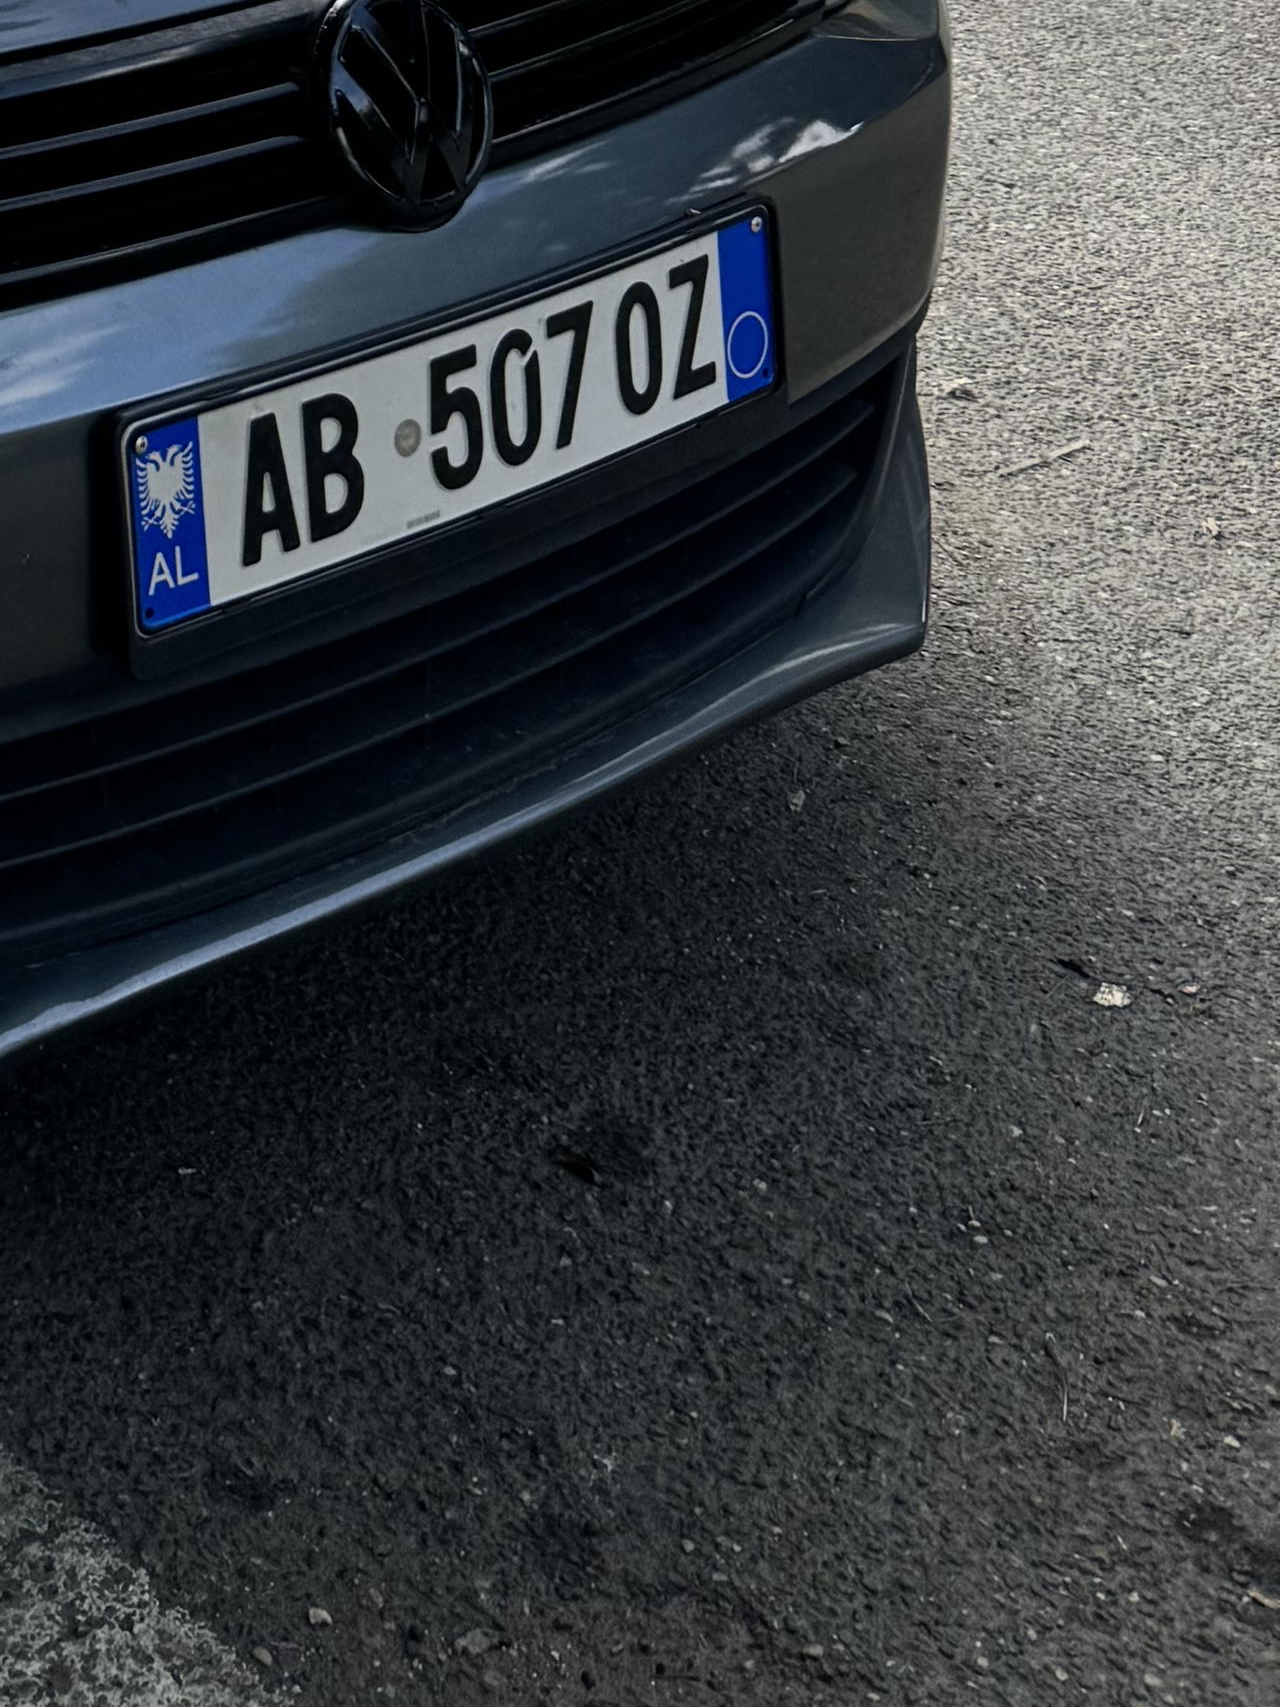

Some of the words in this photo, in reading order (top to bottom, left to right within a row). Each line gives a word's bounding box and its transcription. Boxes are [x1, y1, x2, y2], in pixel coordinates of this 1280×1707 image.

[242, 392, 365, 567] AB
[429, 300, 594, 490] 507
[148, 545, 199, 596] AL
